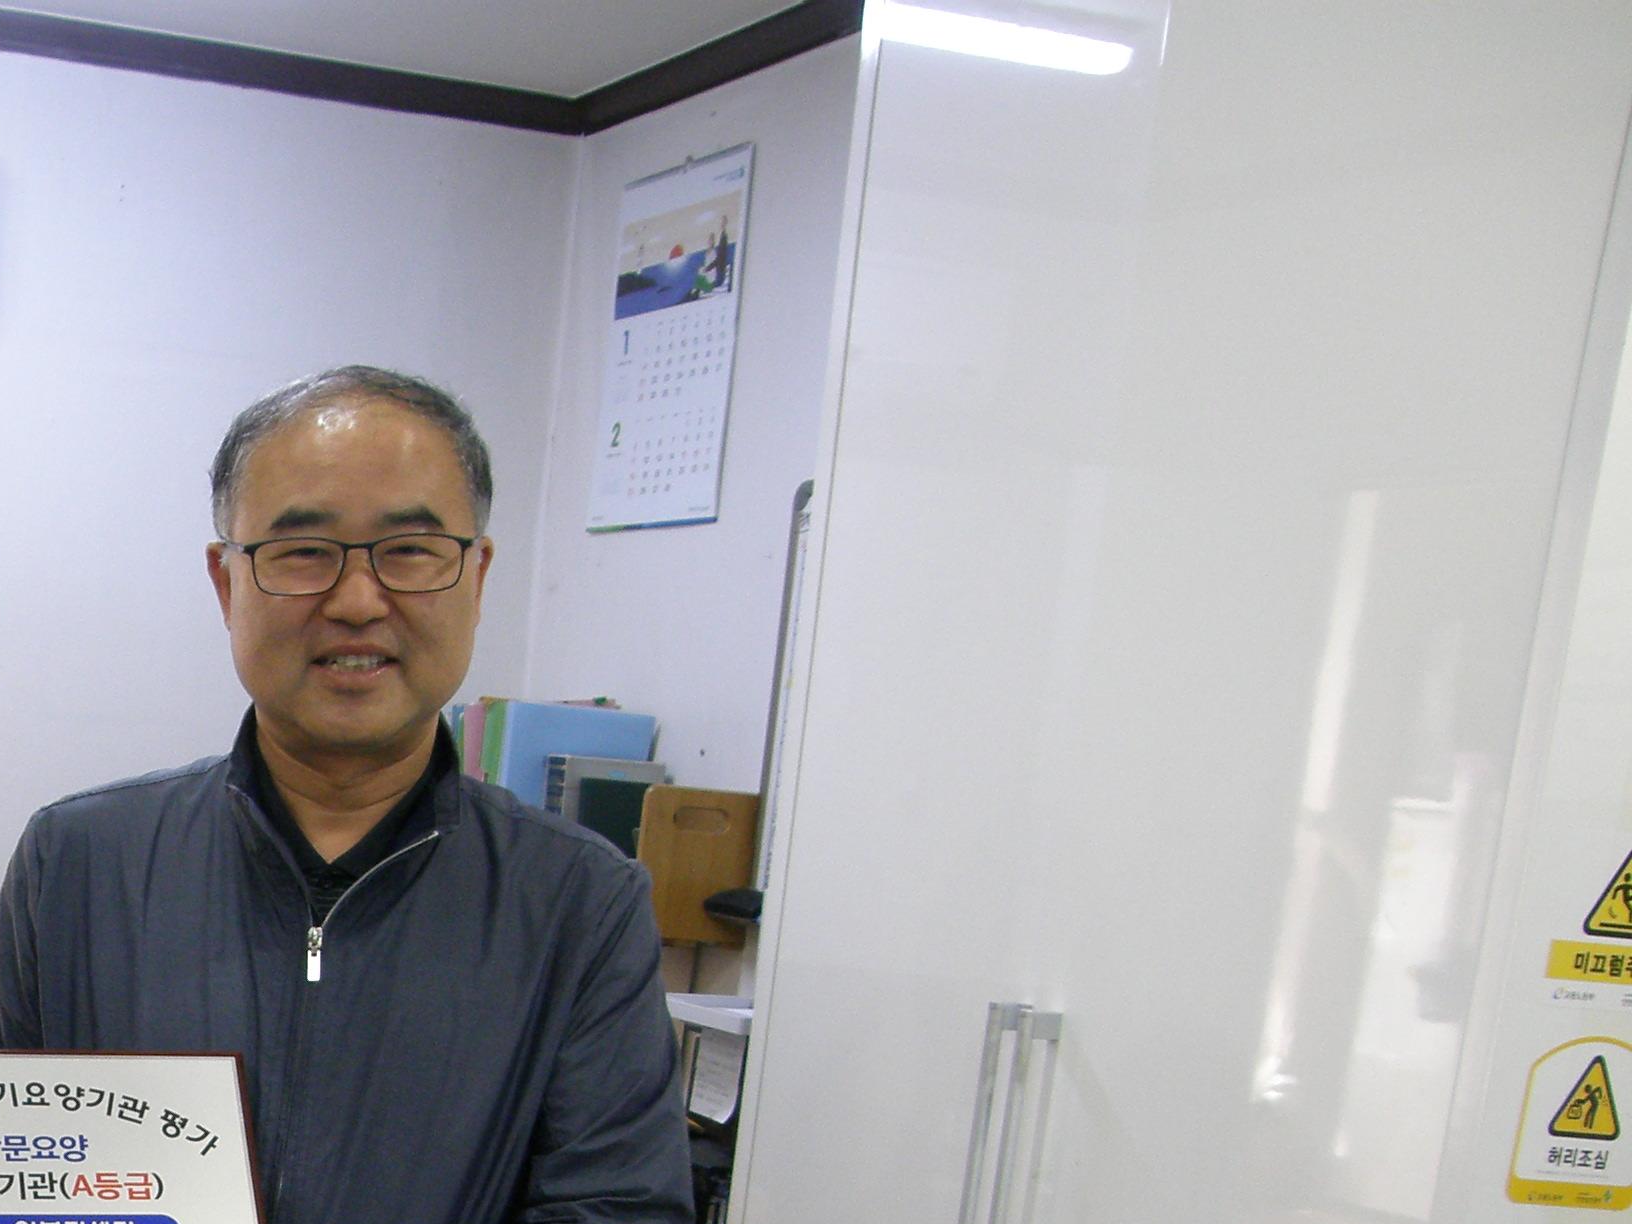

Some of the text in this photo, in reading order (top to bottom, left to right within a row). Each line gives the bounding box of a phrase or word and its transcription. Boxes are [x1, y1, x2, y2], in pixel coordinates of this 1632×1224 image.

[623, 330, 630, 355] 1
[611, 422, 621, 447] 2
[160, 1108, 219, 1156] 평가
[1548, 1147, 1609, 1169] 허리조심
